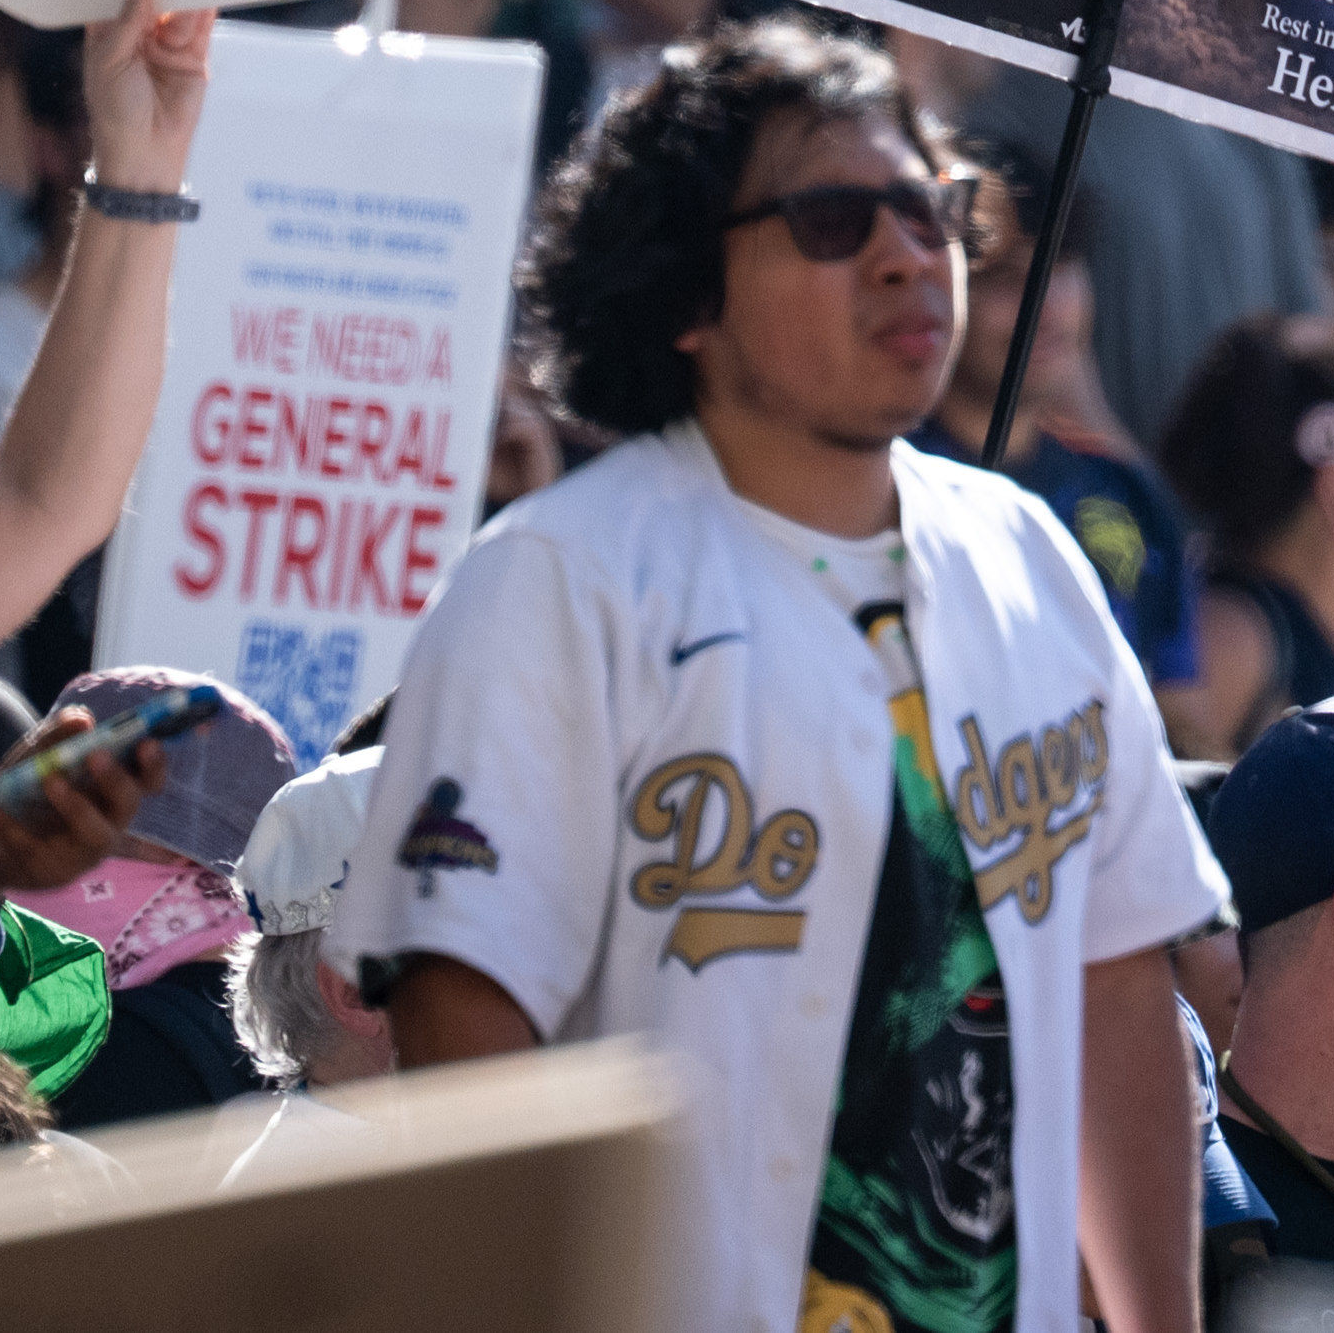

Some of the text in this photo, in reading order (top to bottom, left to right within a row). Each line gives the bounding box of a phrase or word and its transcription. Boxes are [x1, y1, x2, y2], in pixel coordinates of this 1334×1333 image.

[1261, 3, 1311, 41] Rest
[231, 304, 455, 387] WE NEED A
[191, 382, 456, 490] GENERAL
[173, 478, 445, 616] STRIKE
[632, 753, 819, 908] Do
